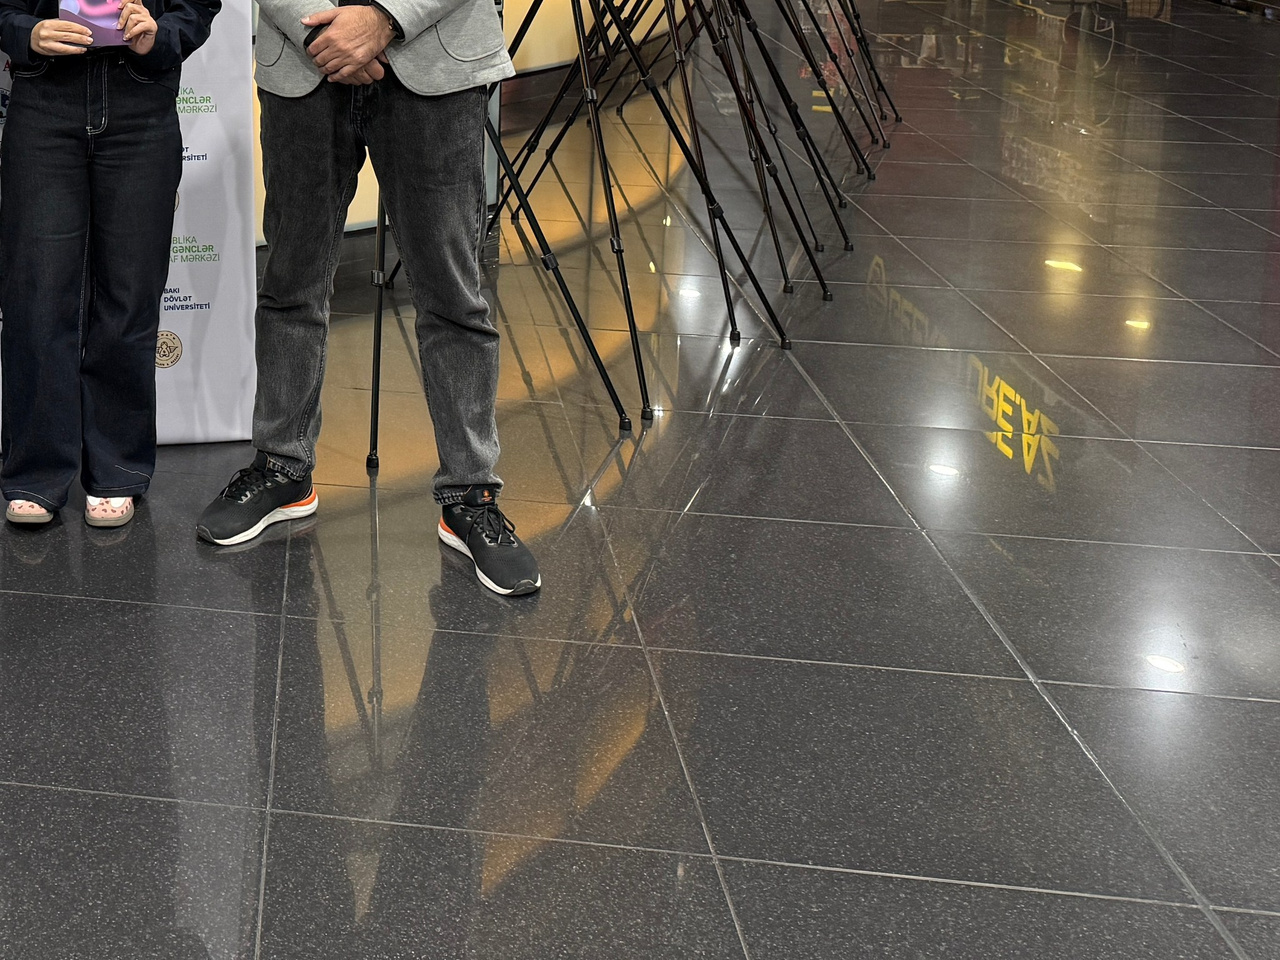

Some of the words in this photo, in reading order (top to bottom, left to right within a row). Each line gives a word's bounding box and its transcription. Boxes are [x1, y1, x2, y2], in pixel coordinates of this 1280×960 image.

[178, 103, 217, 113] MƏRKƏZİ
[172, 235, 197, 244] BLİKA
[180, 253, 220, 262] MƏRKƏZİ
[164, 294, 192, 302] DÖVLƏT
[163, 302, 210, 312] UNİVERSİTETİ
